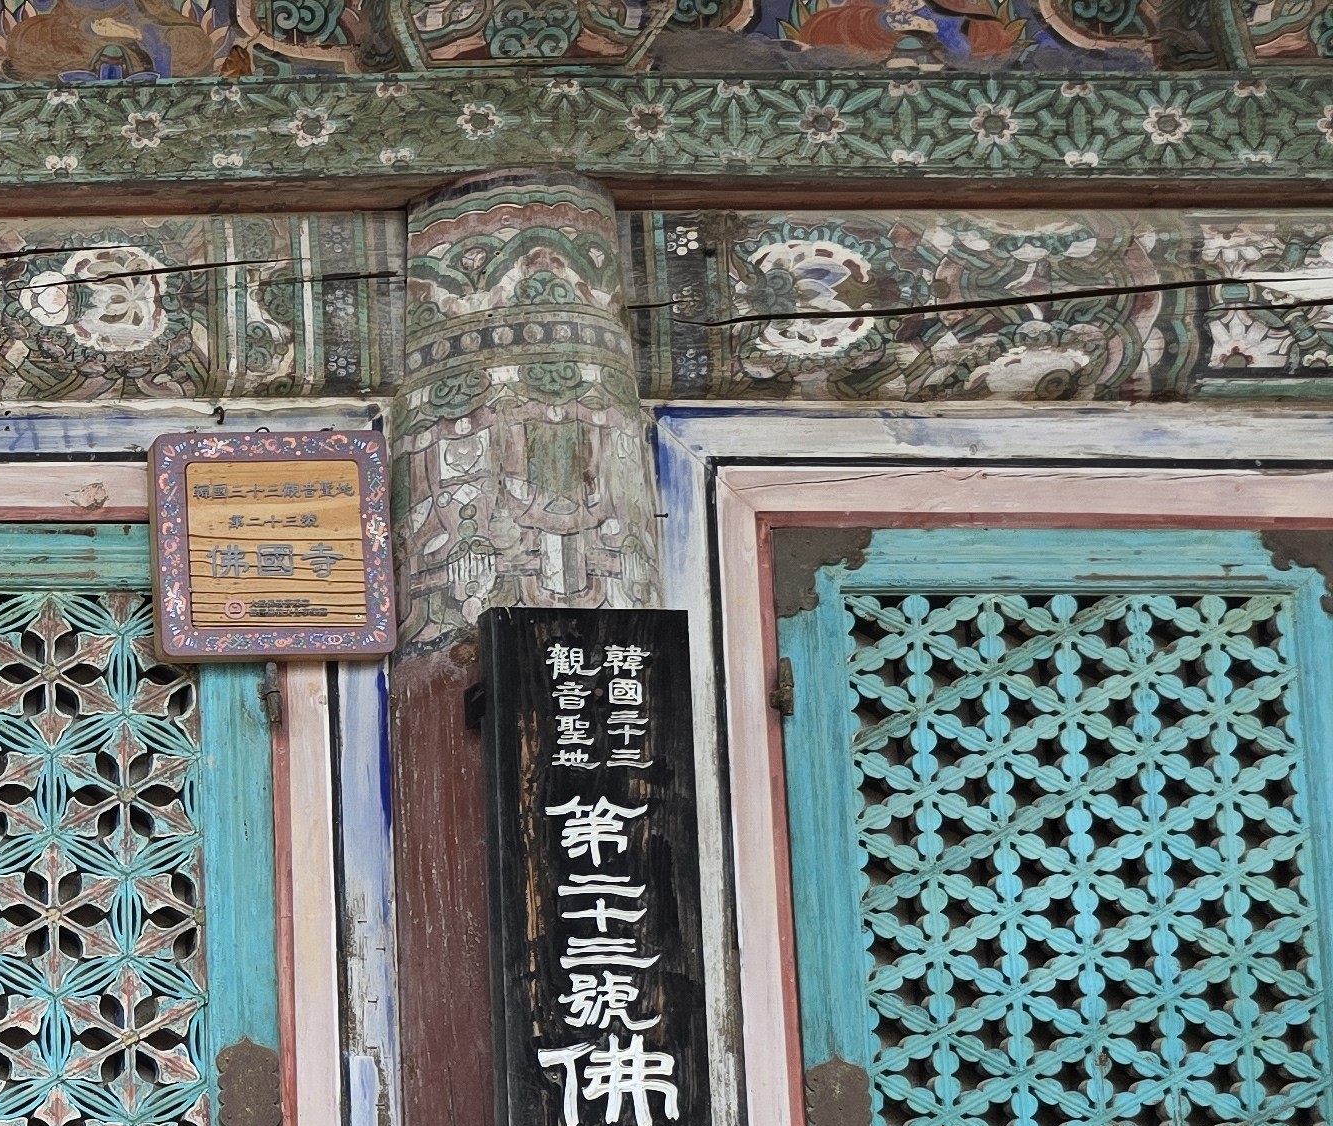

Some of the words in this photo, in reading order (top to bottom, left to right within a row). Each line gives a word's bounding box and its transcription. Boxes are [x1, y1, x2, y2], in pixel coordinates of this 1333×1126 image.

[207, 542, 345, 578] 佛國寺
[545, 643, 602, 770] 觀音聖地
[603, 644, 654, 769] 韓國三十三
